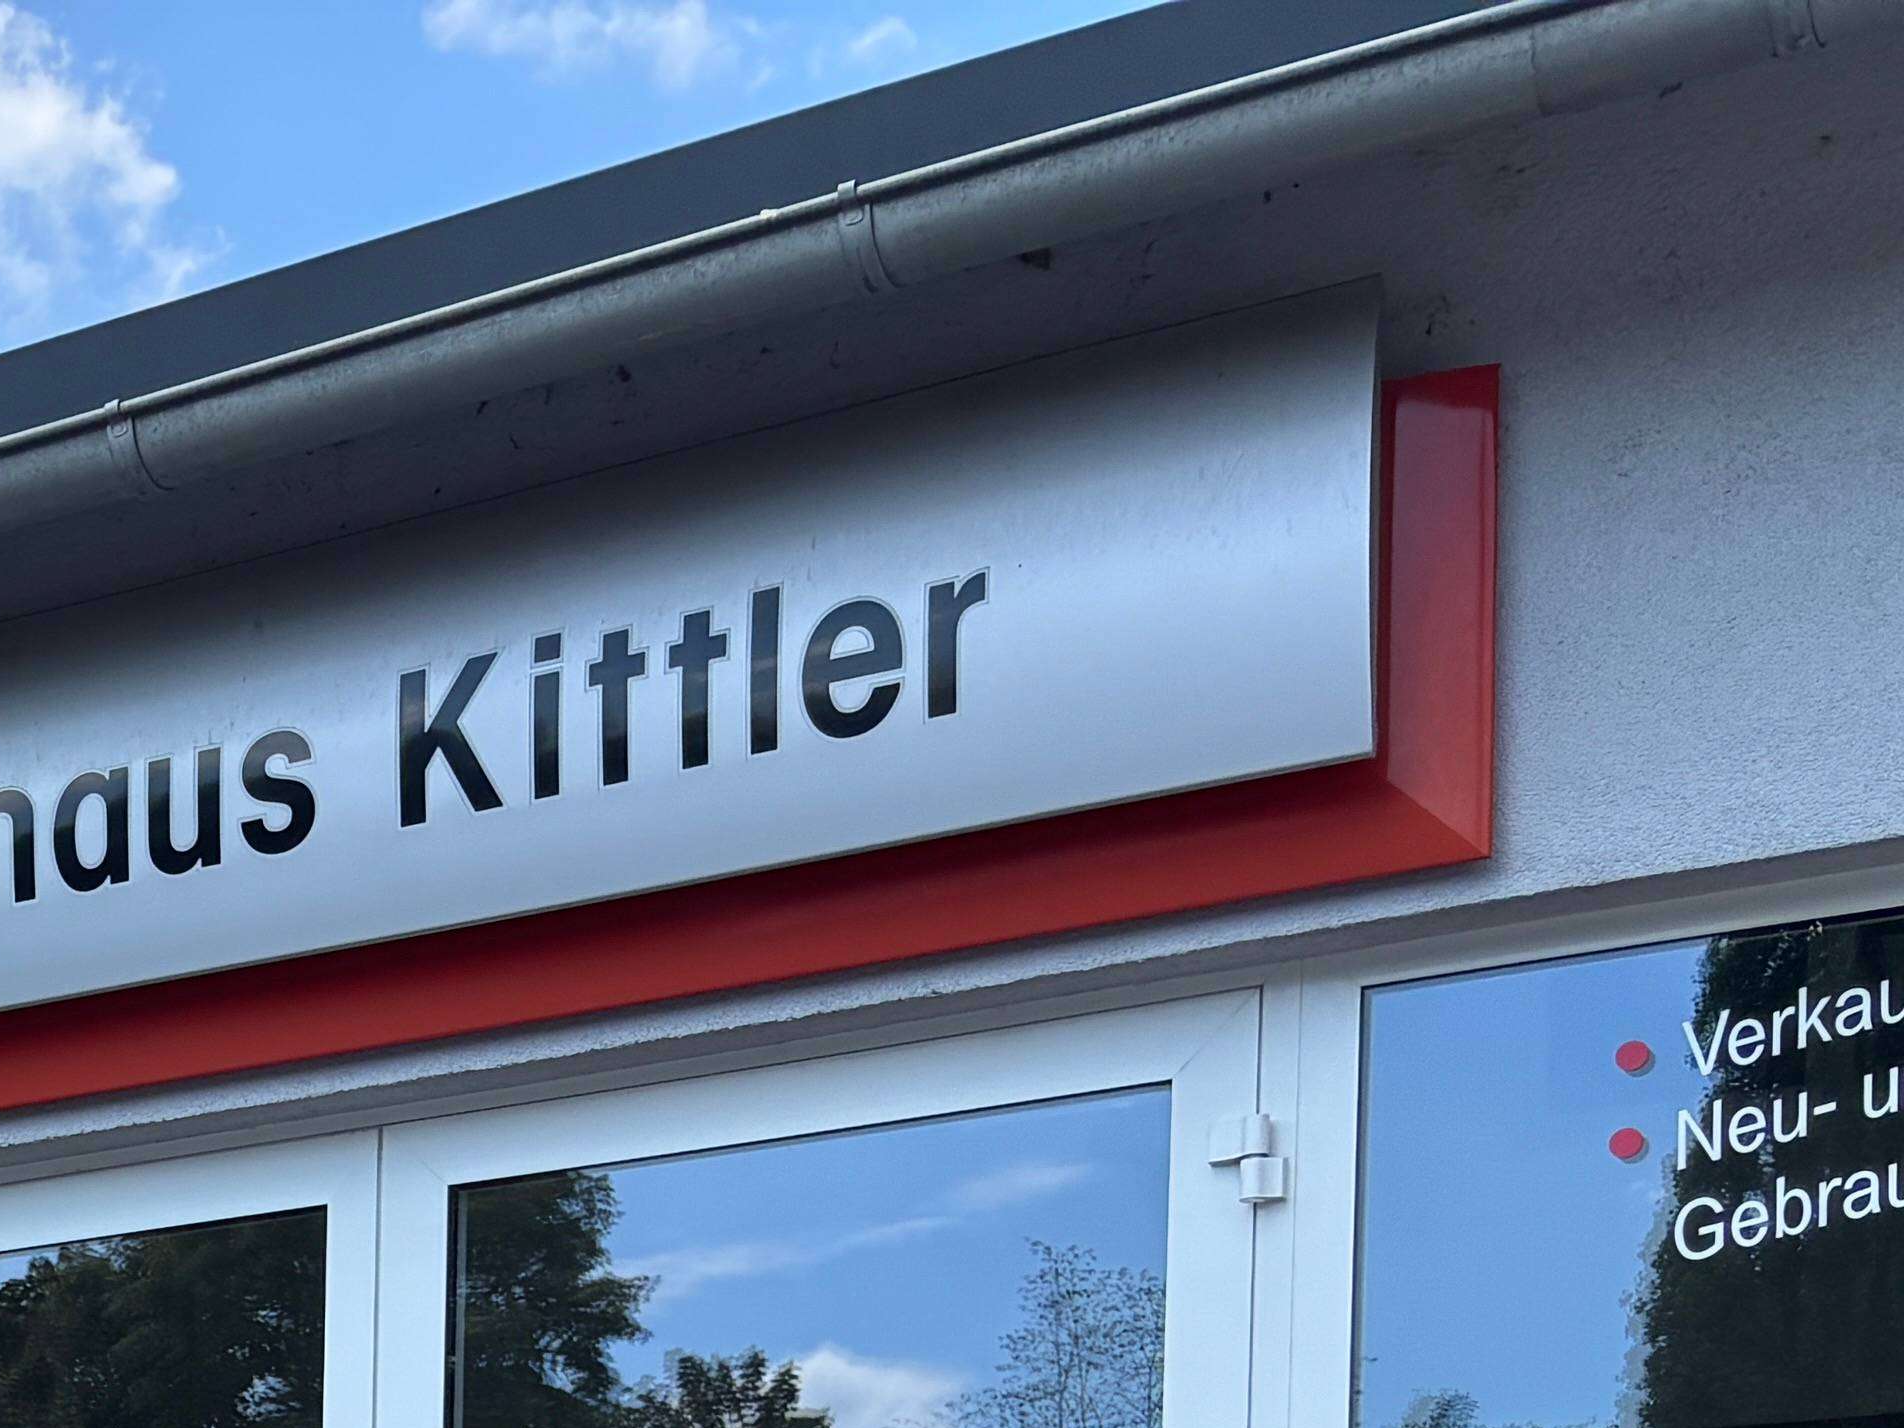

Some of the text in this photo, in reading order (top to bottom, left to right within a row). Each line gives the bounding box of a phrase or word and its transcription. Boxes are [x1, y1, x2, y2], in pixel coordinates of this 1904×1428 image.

[397, 567, 989, 829] Kittler
[1682, 979, 1904, 1076] Verkau
[1677, 1092, 1837, 1171] Neu-
